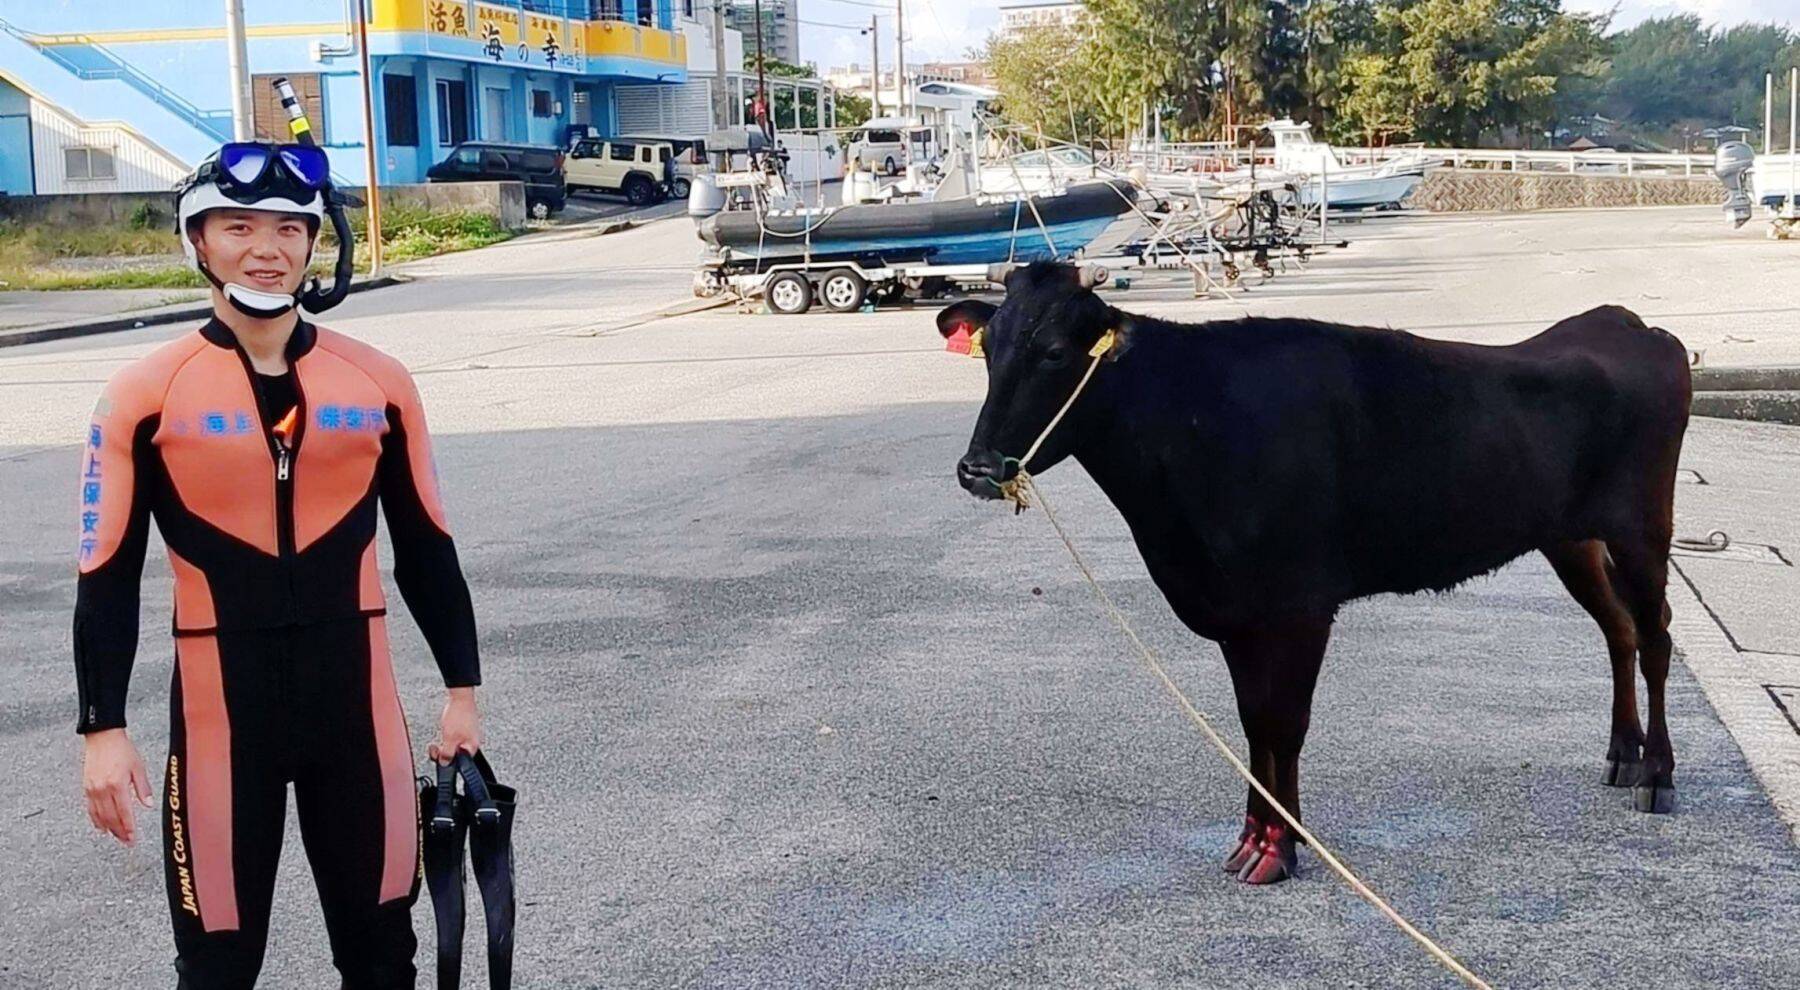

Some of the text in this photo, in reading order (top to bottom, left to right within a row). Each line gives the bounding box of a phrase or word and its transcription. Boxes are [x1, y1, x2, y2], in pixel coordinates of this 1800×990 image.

[430, 1, 468, 38] 活魚
[481, 23, 560, 70] 海の幸
[80, 424, 102, 558] 海上保安庁
[169, 754, 198, 917] JAPAN COAST GUARD
